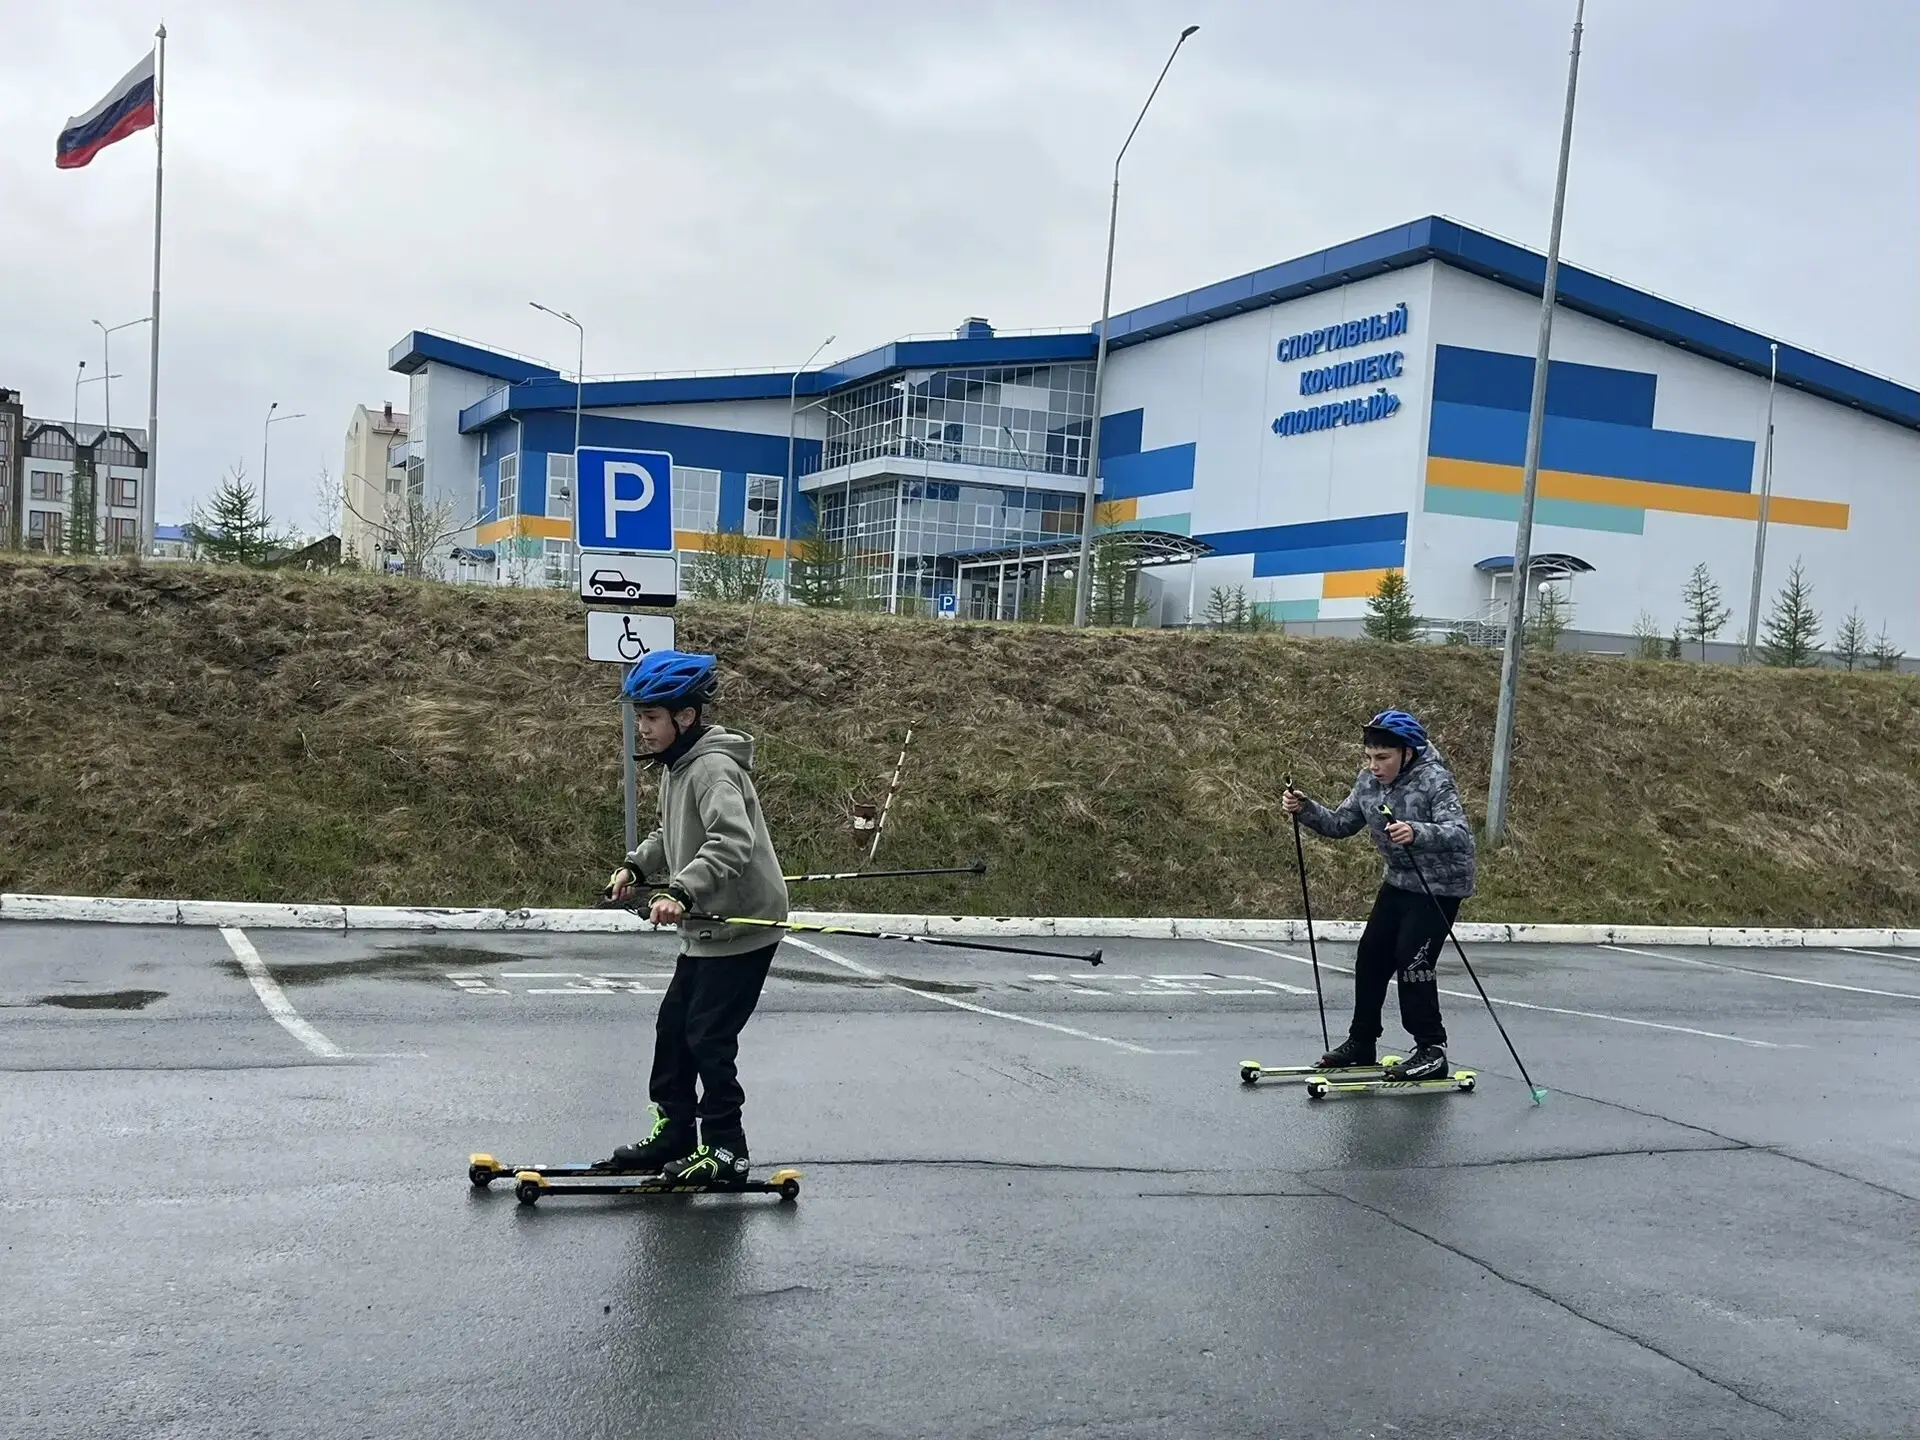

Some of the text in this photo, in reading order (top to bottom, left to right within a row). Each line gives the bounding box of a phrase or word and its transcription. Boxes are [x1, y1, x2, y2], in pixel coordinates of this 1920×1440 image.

[1277, 302, 1408, 362] СПОРТИВНЫЙ
[1300, 351, 1404, 396] КОМПЛЕКС
[1271, 387, 1401, 437] «ПОЛЯРНЫЙ»
[604, 461, 655, 538] P
[943, 596, 953, 610] P
[714, 1148, 734, 1165] TREK
